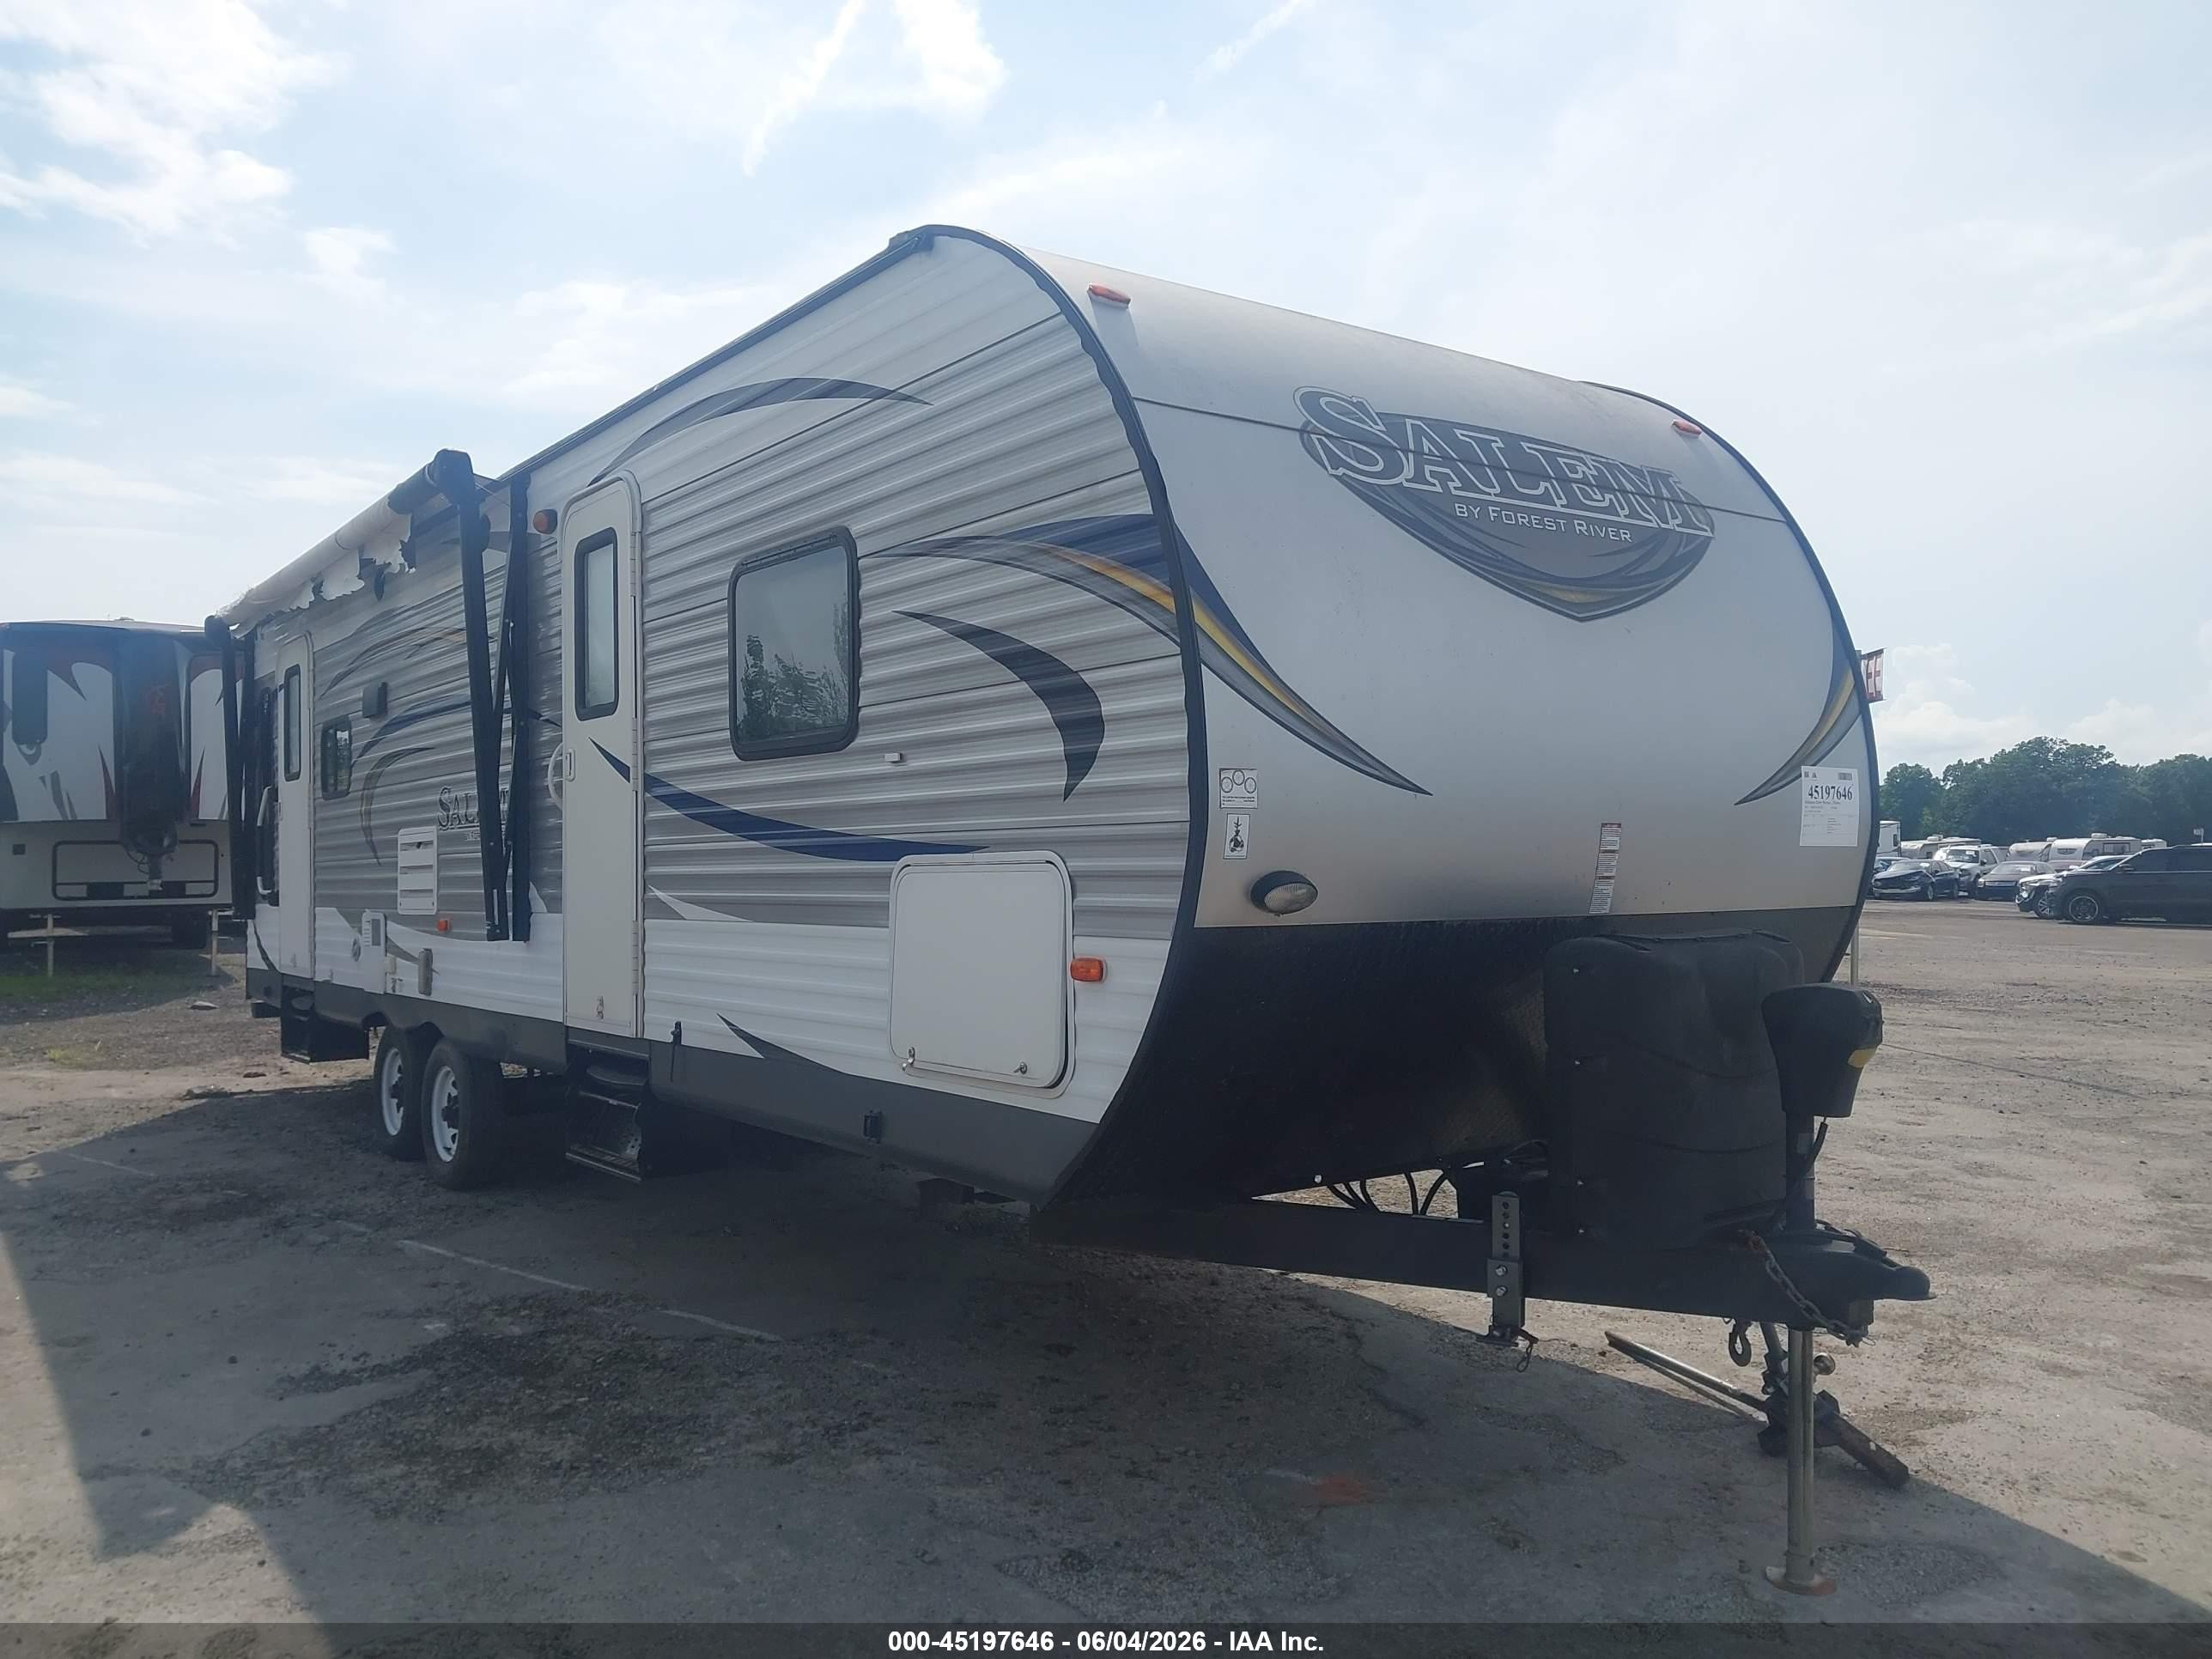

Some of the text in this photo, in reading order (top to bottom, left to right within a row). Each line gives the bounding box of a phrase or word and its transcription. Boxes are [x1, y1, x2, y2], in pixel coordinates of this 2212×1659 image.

[1292, 386, 1716, 538] SALEM
[1455, 503, 1632, 543] BY FOREST RIVER
[1808, 785, 1853, 800] 45197646
